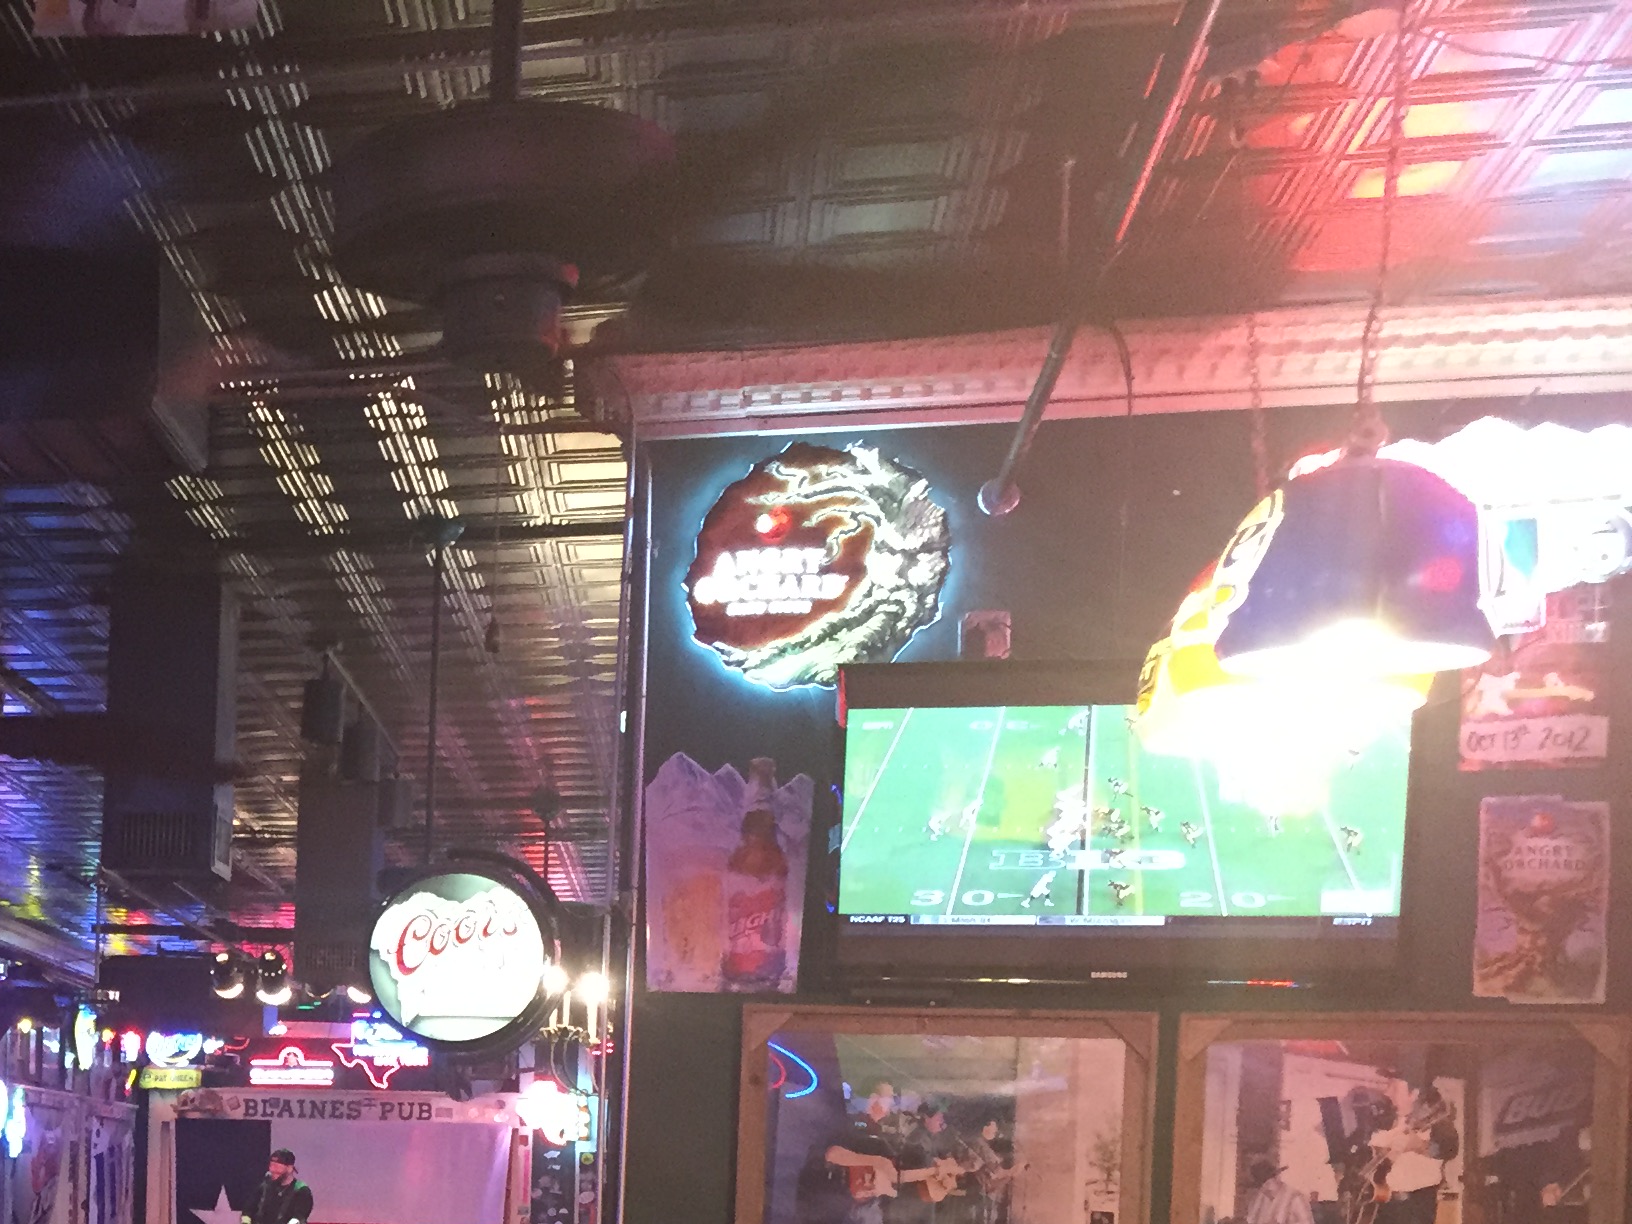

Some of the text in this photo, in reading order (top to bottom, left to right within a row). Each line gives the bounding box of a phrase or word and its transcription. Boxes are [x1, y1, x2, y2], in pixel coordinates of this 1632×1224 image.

[1539, 726, 1591, 751] 2012
[1503, 858, 1587, 871] ORCHARD
[392, 899, 520, 976] Coors
[243, 1096, 433, 1121] BLAINES PUB
